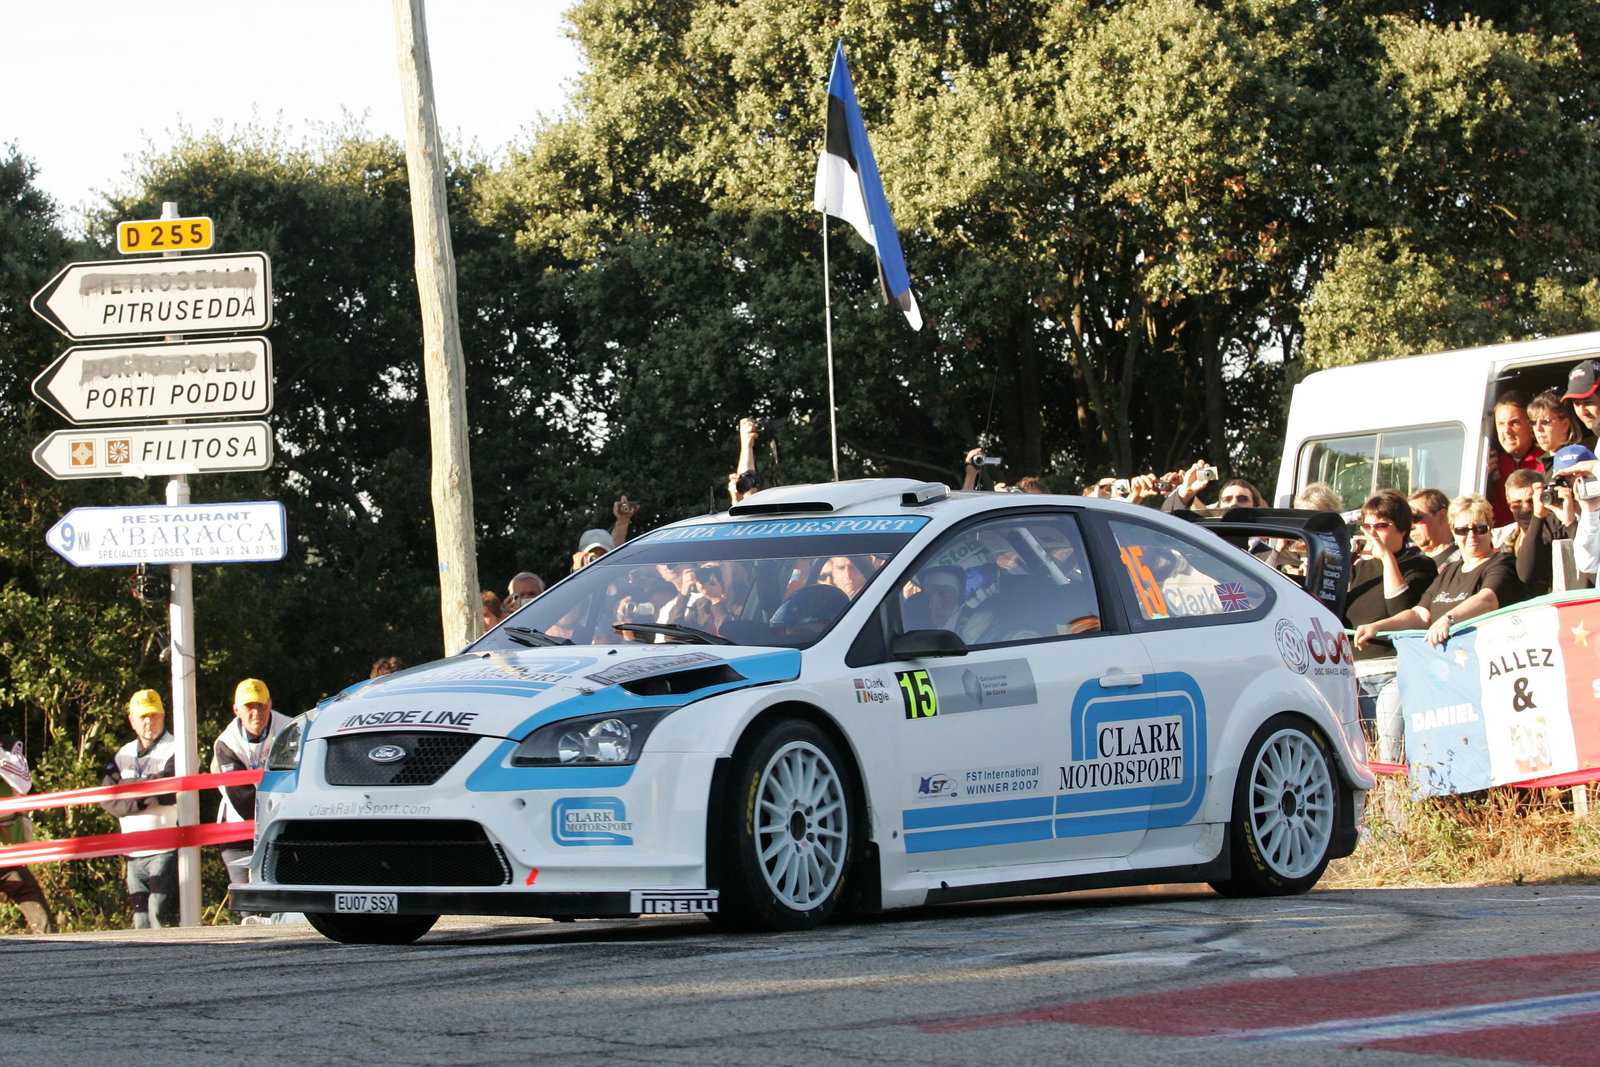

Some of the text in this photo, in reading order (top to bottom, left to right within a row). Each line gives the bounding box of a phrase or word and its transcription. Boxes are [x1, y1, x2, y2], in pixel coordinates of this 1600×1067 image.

[127, 223, 203, 247] D 255
[103, 296, 256, 324] PITRUSEDDA
[86, 380, 256, 409] PORTI PODDU
[142, 436, 257, 461] FILITOSA
[122, 511, 252, 524] RESTAURANT
[724, 518, 914, 537] MOTORSPORT
[60, 522, 91, 552] 9 KM
[153, 547, 185, 558] CORSES
[190, 546, 204, 557] TEL
[240, 545, 250, 555] 24
[255, 545, 265, 555] 23
[1120, 546, 1168, 616] 15
[1164, 587, 1223, 616] Clark
[1489, 648, 1554, 680] ALLEZ
[864, 678, 885, 690] Clark
[899, 671, 937, 719] 15
[1513, 677, 1537, 713] &
[867, 690, 890, 704] Nagle
[345, 710, 479, 728] INSIDE LINE
[1411, 702, 1480, 733] DANIEL
[1099, 722, 1181, 758] CLARK
[374, 746, 397, 759] Ford
[966, 766, 1039, 781] FST International
[1059, 756, 1181, 790] MOTORSPORT
[966, 780, 1039, 795] WINNER 2007
[309, 801, 431, 817] ClarkRallySport.com
[566, 811, 613, 823] CLARK
[566, 822, 633, 833] MOTORSPORT
[338, 896, 395, 910] EU07 SSX
[630, 889, 720, 913] PIRELLI
